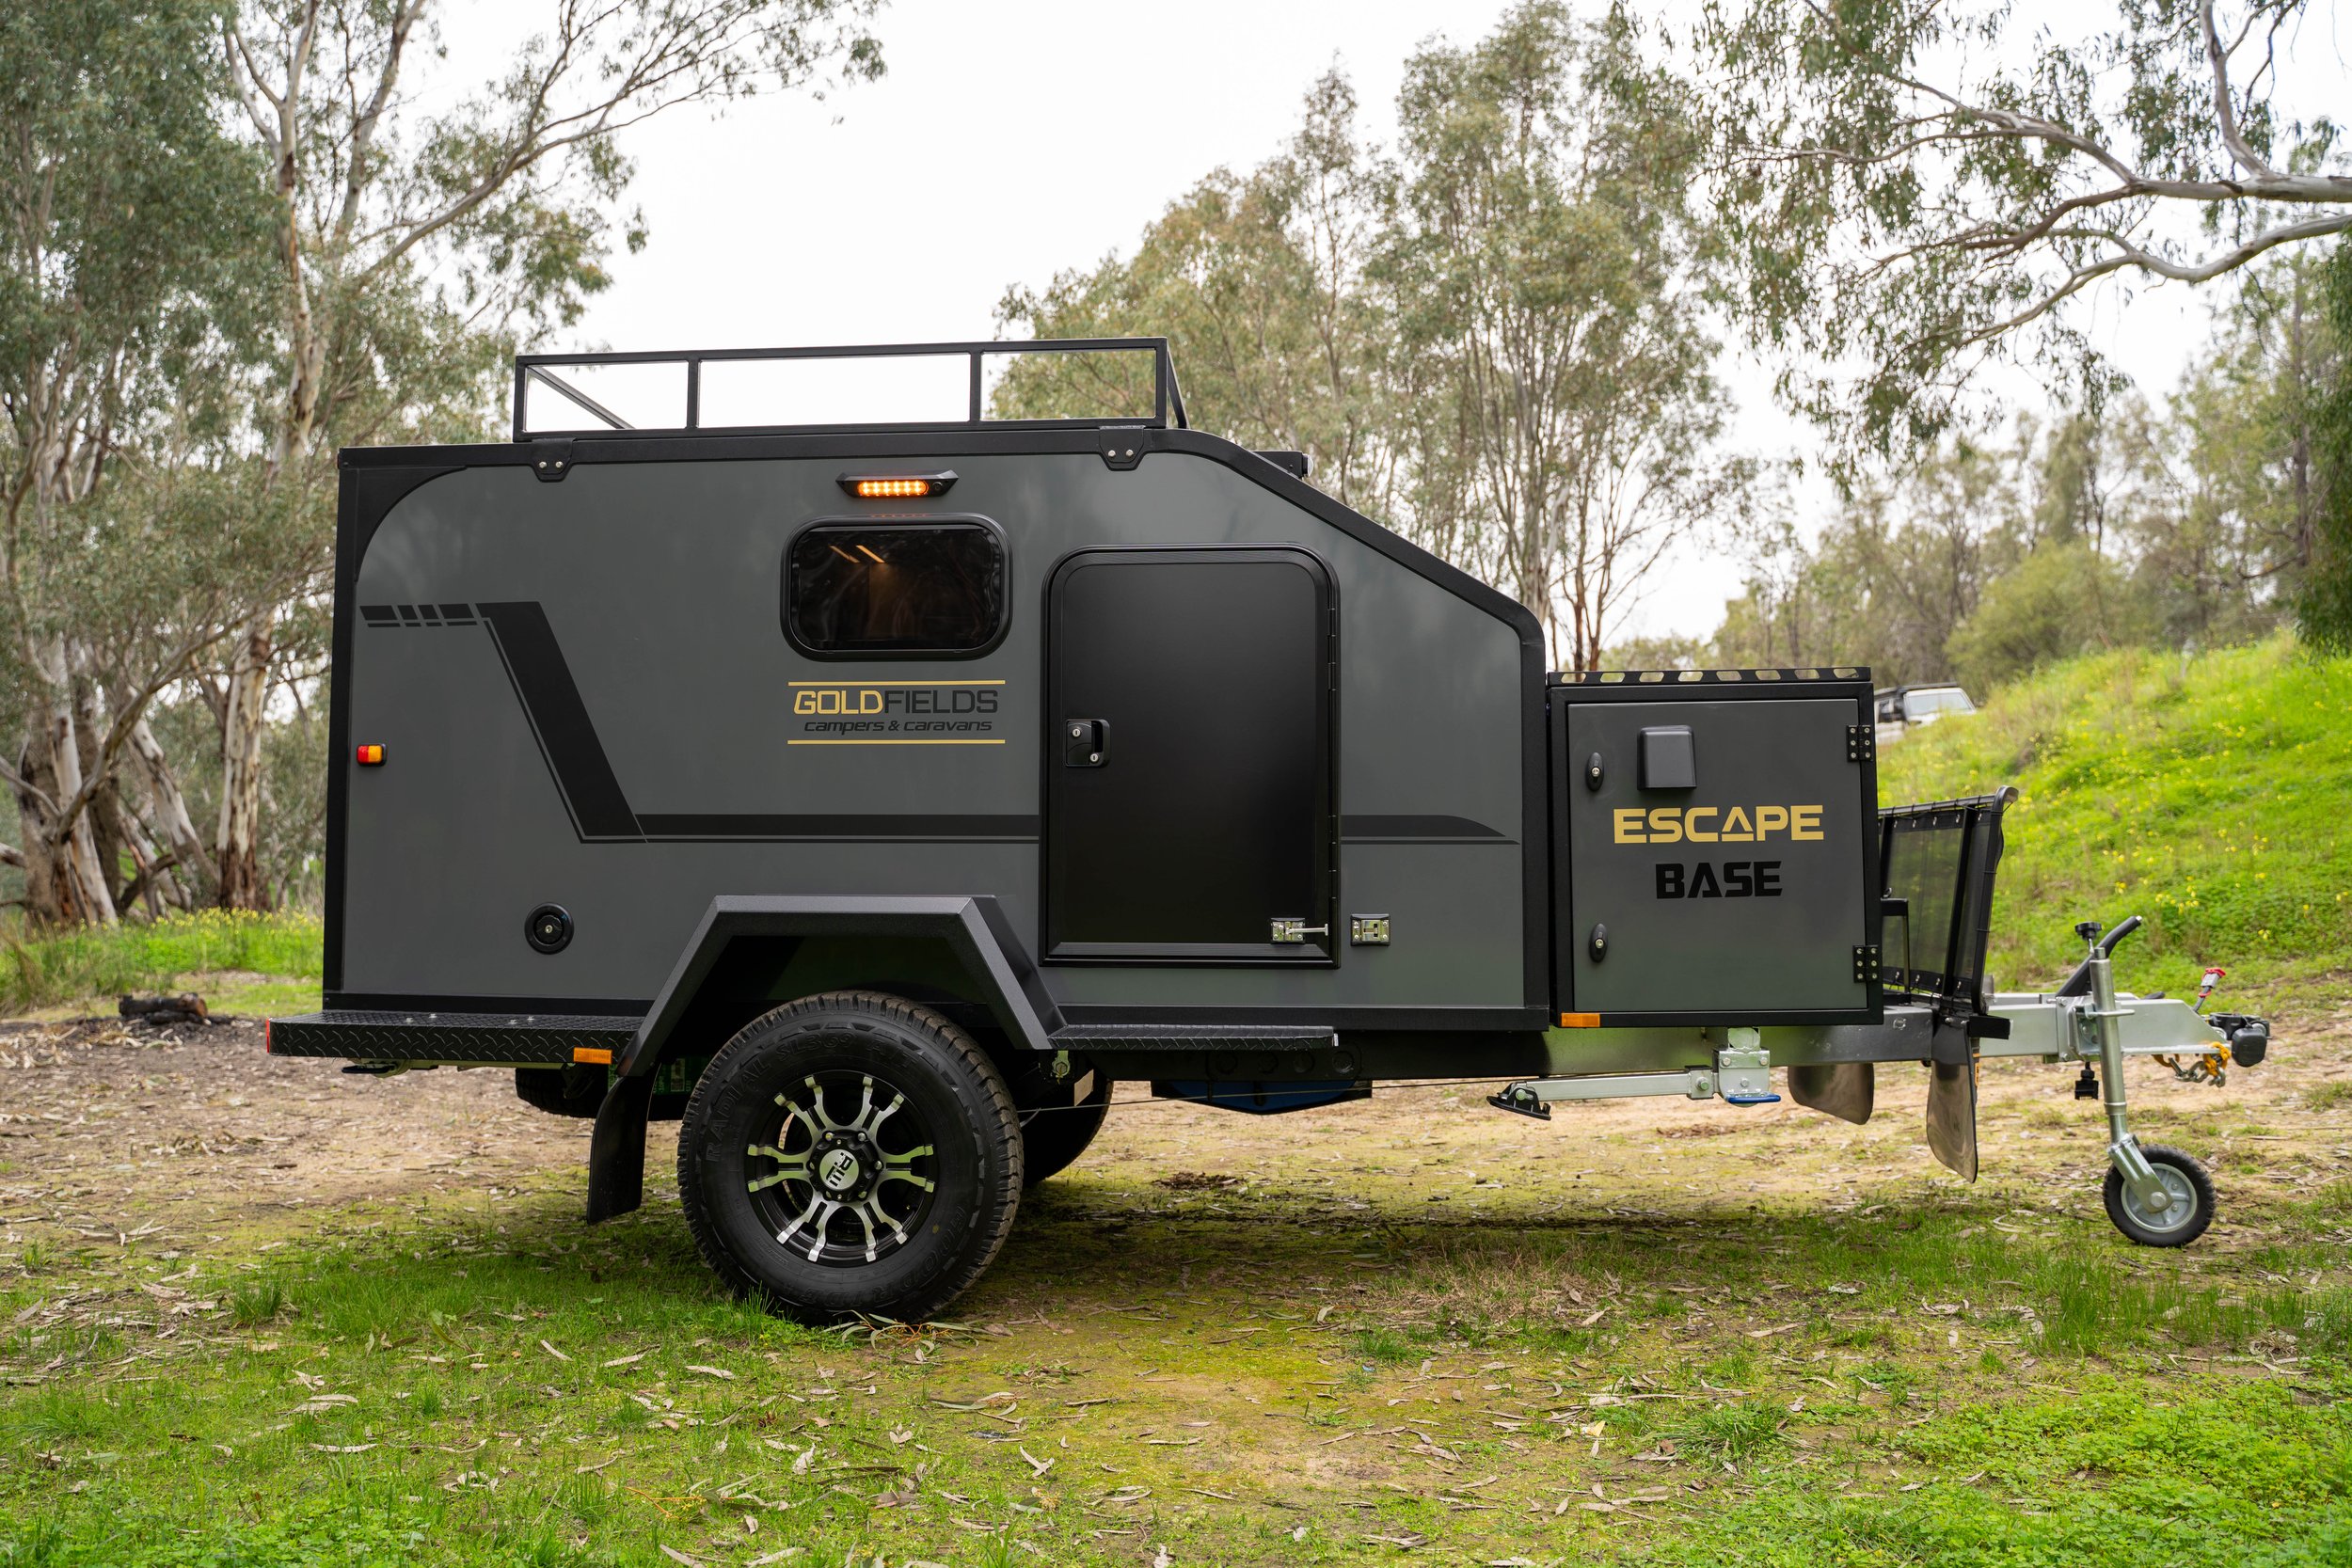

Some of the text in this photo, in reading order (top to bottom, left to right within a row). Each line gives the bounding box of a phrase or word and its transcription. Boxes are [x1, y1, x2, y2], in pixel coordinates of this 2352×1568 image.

[793, 689, 998, 715] GOLDFIELDS
[803, 721, 993, 736] campers & caravans
[1613, 804, 1824, 844] ESCAPE
[1655, 861, 1783, 899] BASE
[706, 1058, 771, 1163] RADIAL
